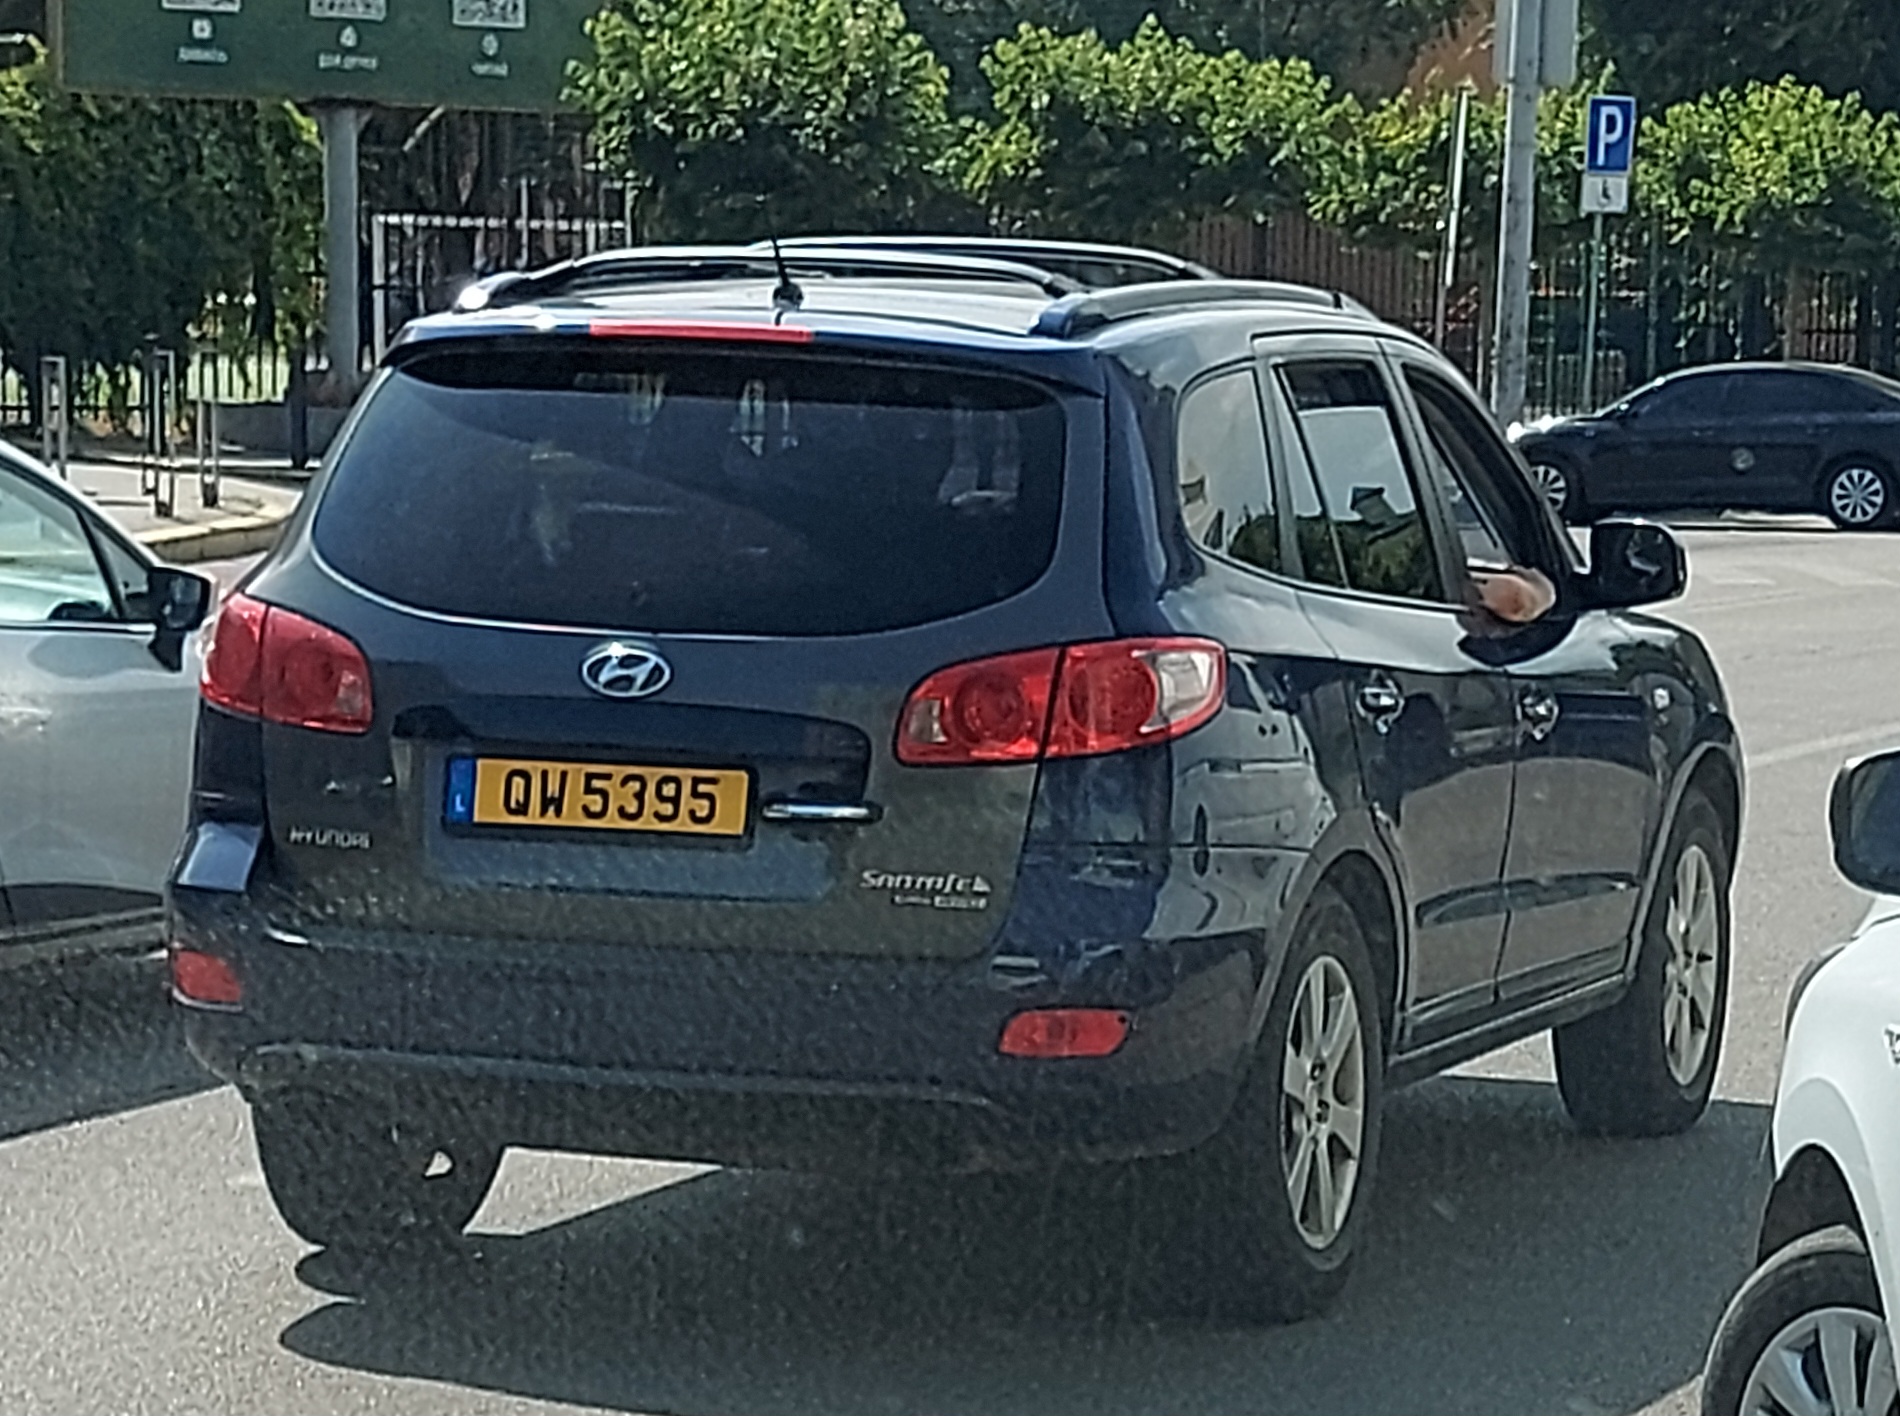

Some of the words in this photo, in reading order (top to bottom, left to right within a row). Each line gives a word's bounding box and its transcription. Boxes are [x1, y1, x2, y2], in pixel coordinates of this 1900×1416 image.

[1597, 105, 1623, 166] P
[455, 793, 465, 812] L
[503, 769, 568, 818] QW
[581, 772, 720, 825] 5395
